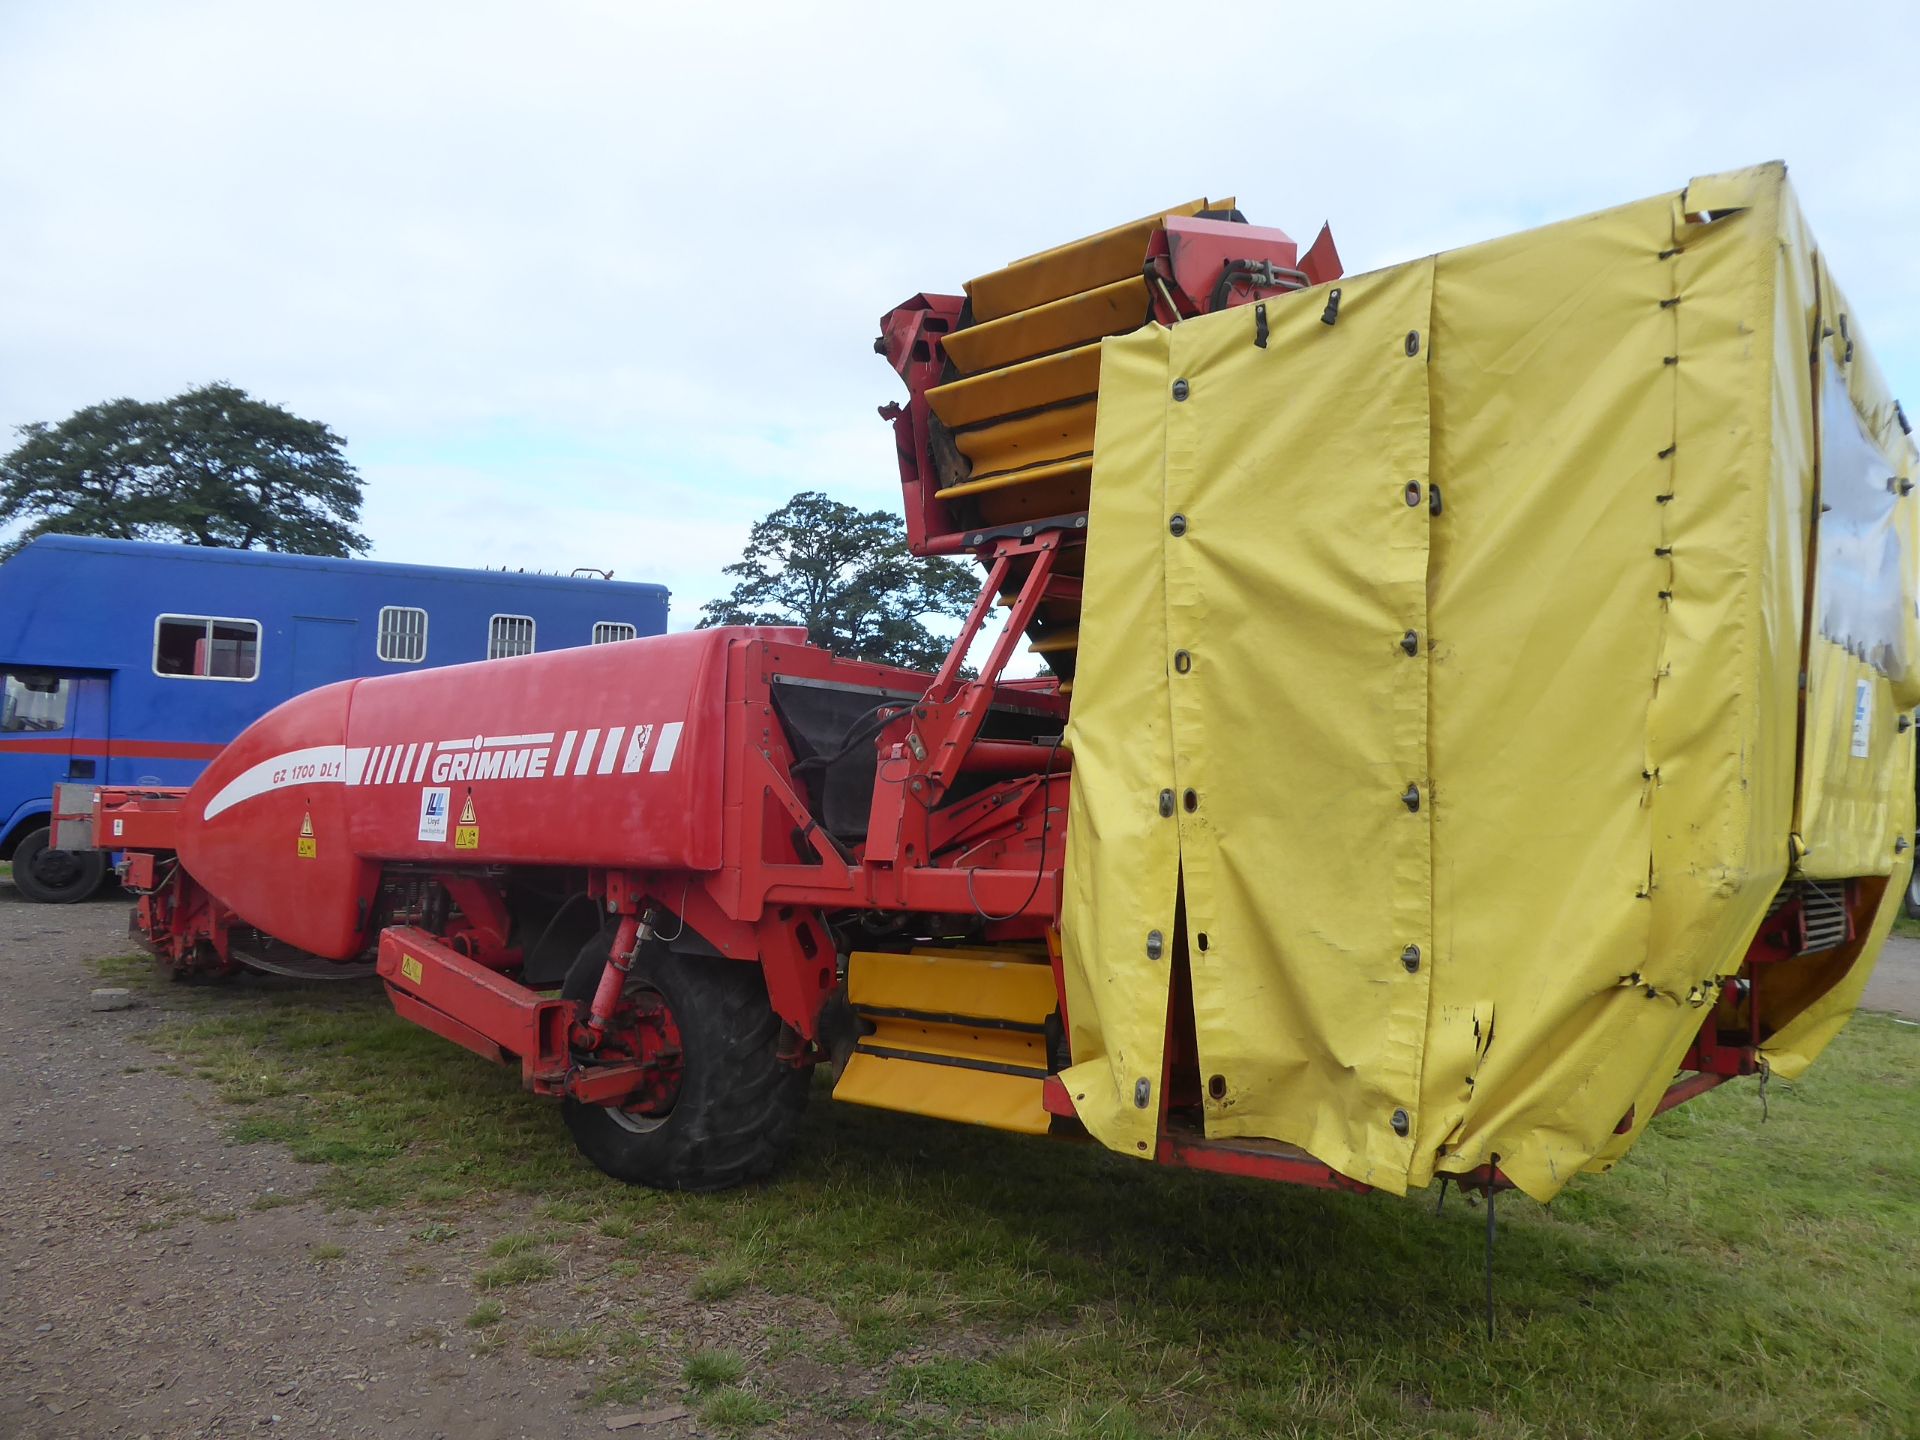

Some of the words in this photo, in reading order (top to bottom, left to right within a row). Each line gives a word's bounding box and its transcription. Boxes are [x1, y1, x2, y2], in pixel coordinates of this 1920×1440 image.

[273, 769, 287, 784] GZ
[292, 764, 316, 780] 1700
[432, 735, 551, 783] GRIMME
